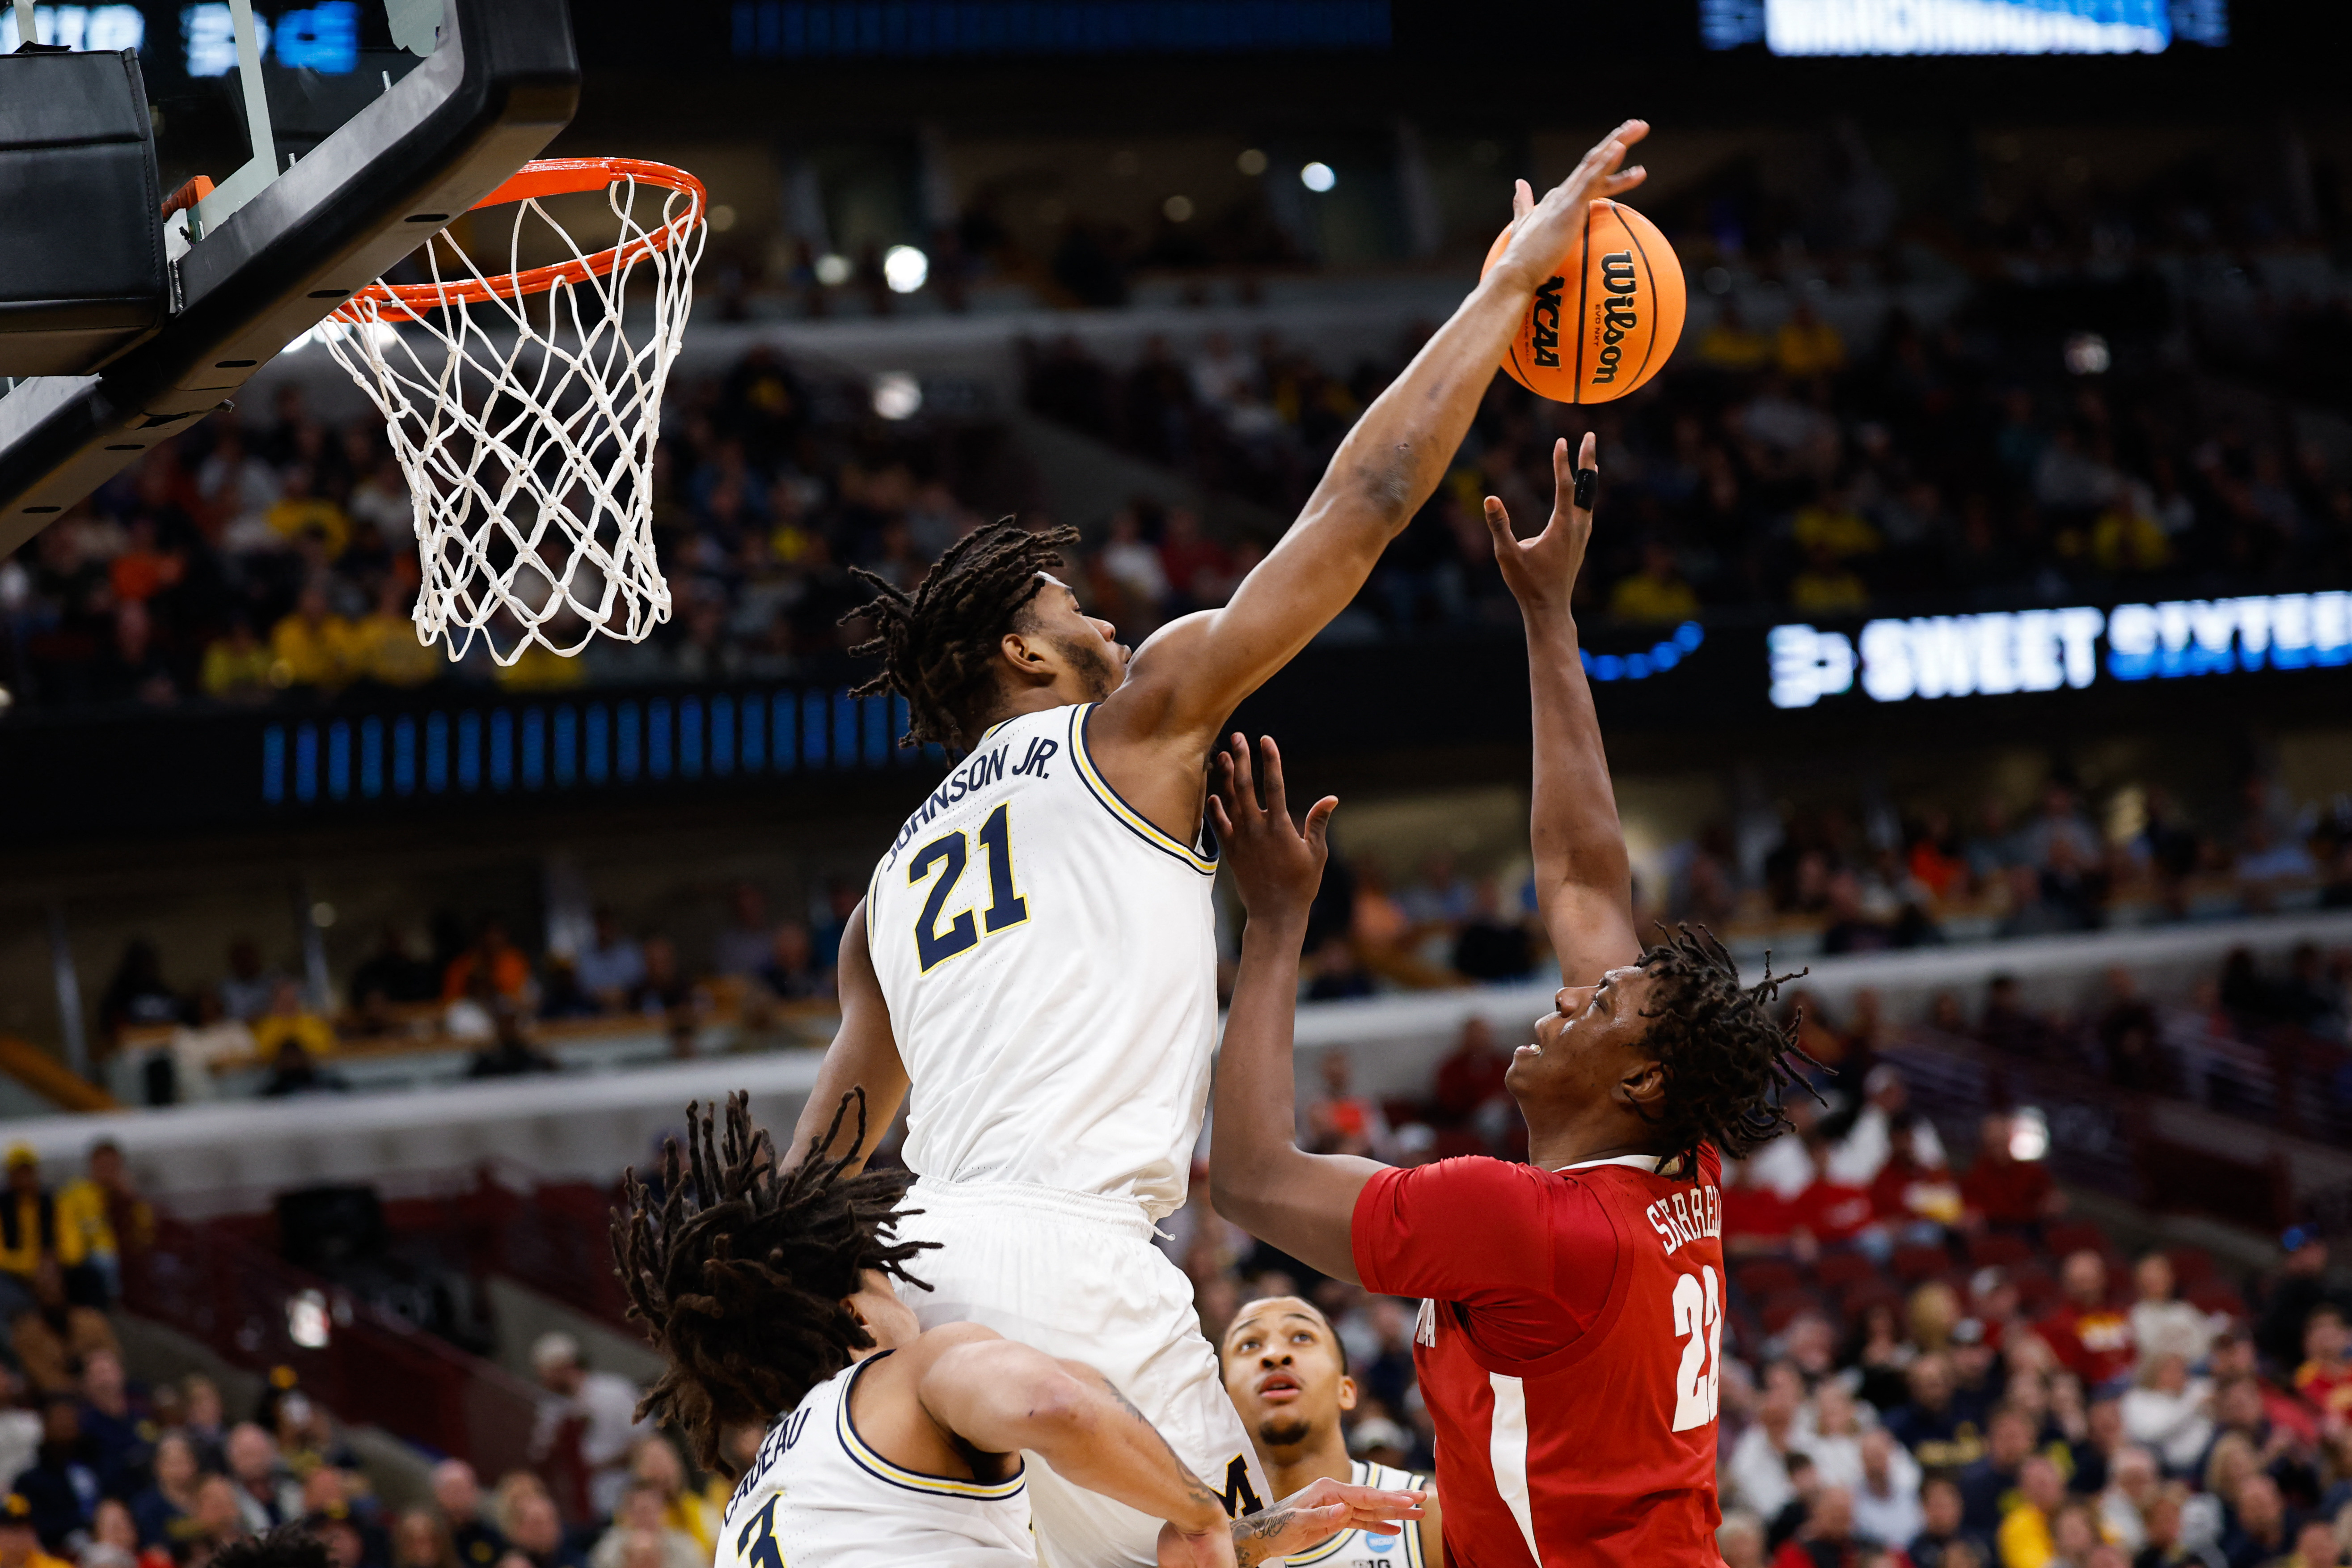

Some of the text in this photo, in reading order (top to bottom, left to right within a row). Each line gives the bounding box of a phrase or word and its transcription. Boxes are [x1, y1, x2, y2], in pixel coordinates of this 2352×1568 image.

[1532, 275, 1565, 368] NCAA
[1592, 249, 1637, 385] Wilson
[1860, 606, 2105, 702] SWEET
[887, 737, 1058, 872] JOHNSON JR.
[907, 799, 1031, 977] 21
[724, 1407, 811, 1528] CADEAU
